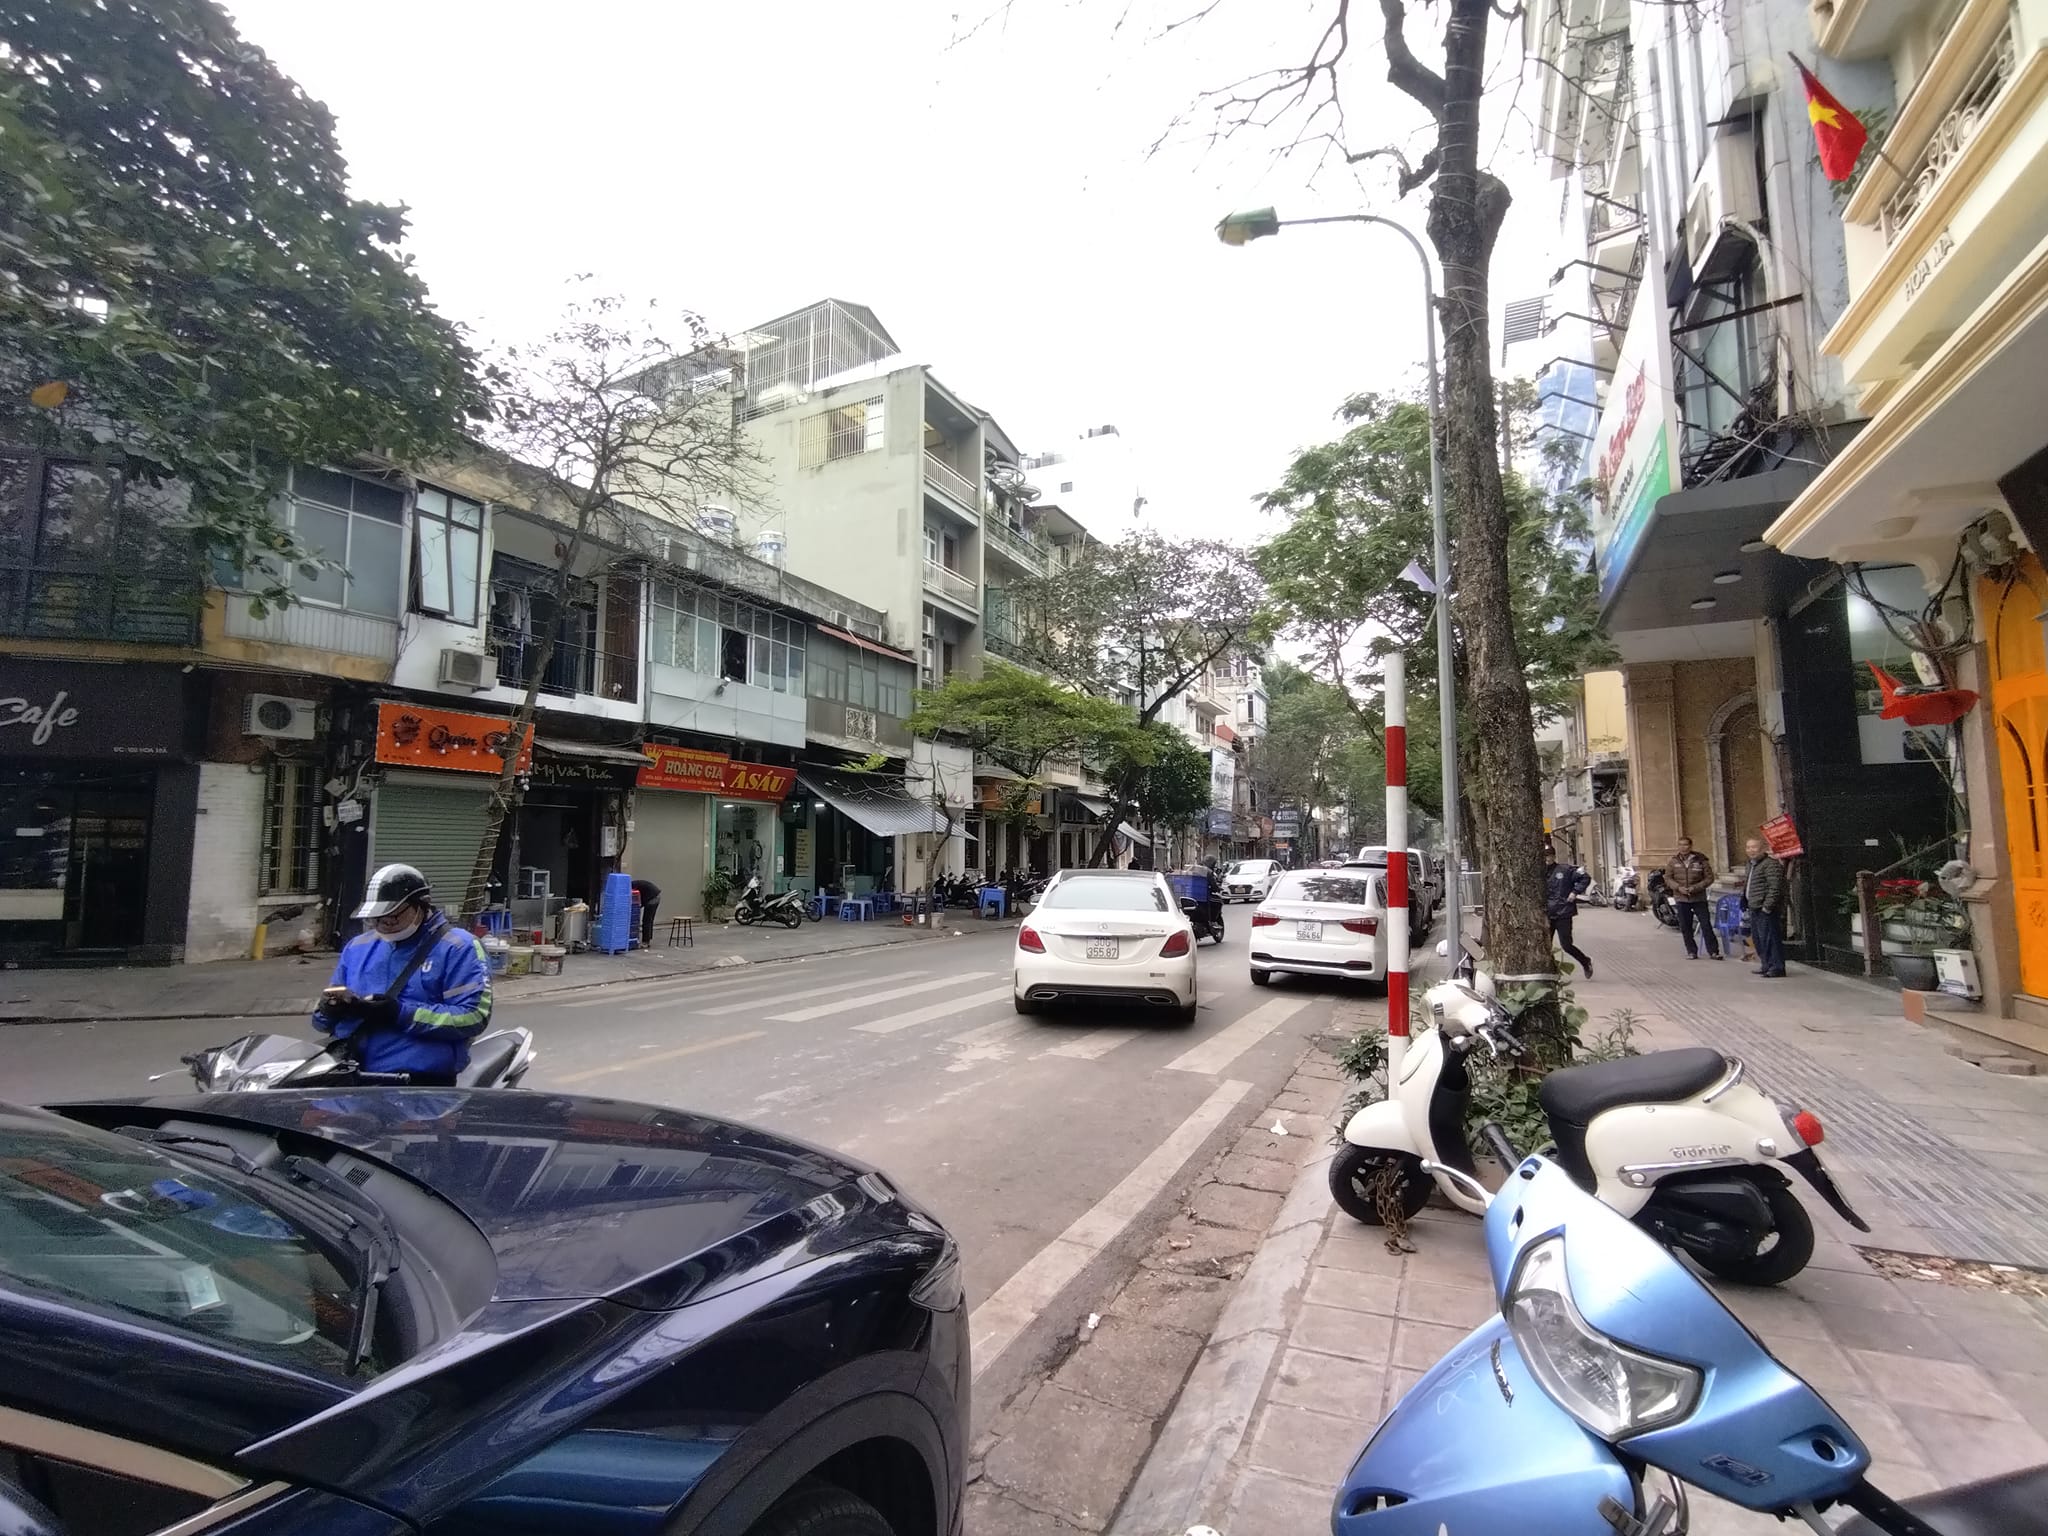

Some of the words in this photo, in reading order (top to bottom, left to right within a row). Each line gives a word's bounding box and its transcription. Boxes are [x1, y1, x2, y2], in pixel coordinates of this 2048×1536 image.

[664, 758, 703, 777] HOÀNG
[704, 765, 723, 779] GIA
[1087, 946, 1117, 958] 355.87
